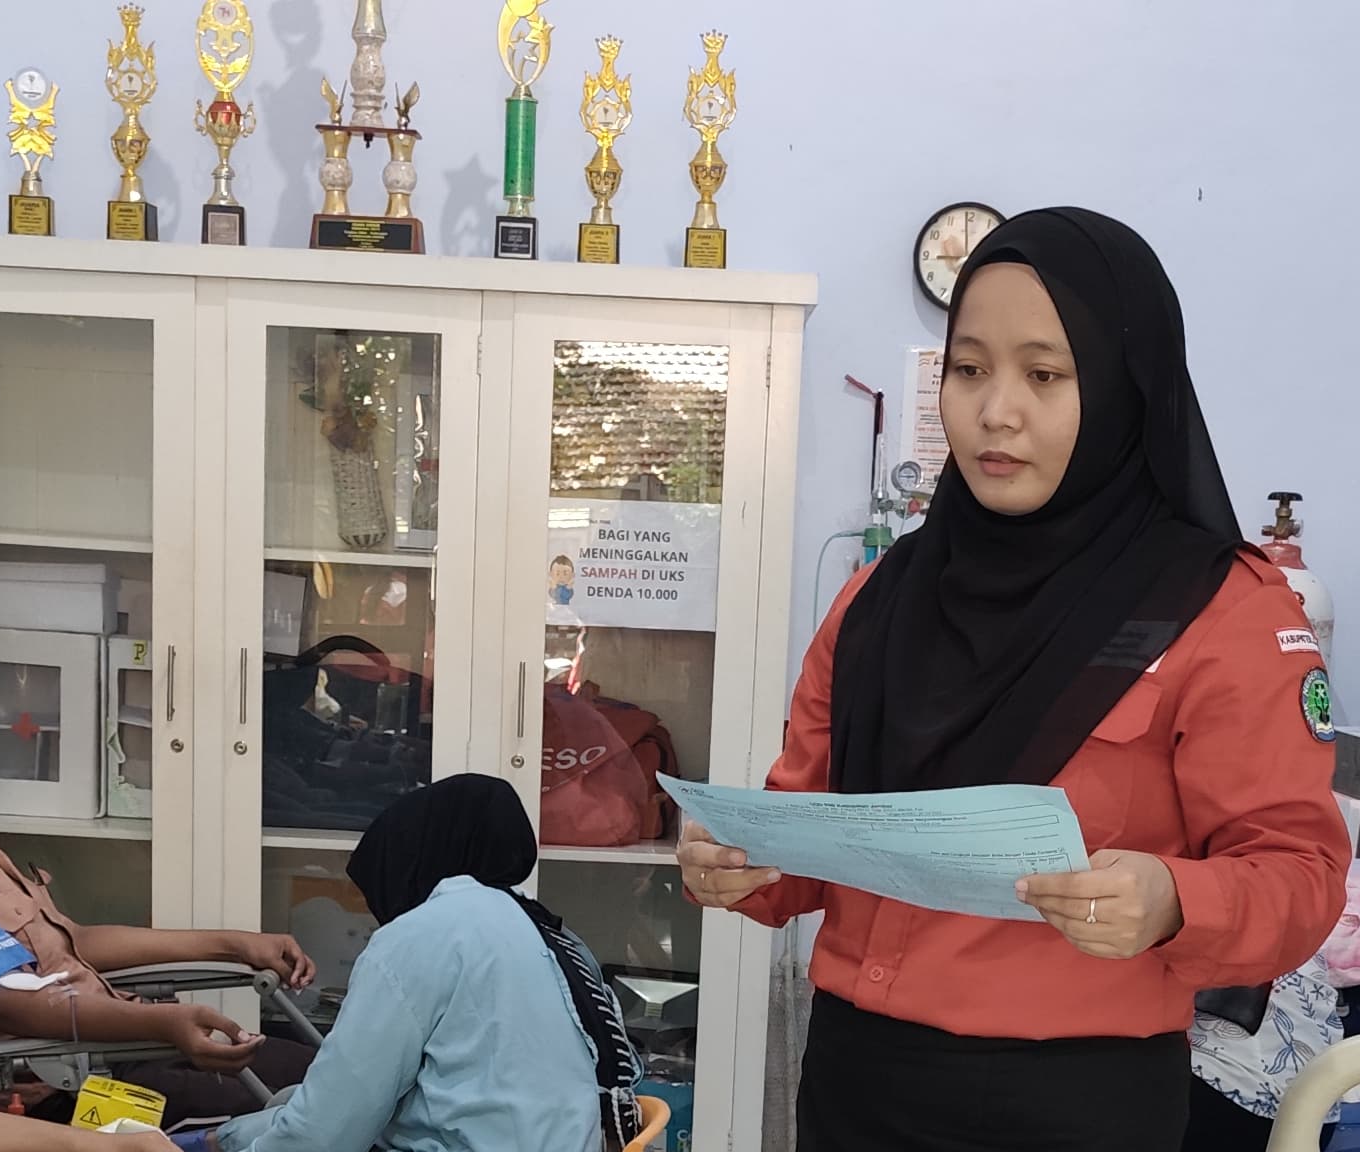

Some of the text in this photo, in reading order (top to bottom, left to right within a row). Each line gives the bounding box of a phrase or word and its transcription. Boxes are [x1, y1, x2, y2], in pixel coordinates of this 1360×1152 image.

[929, 230, 940, 240] 10
[922, 251, 930, 260] 9
[598, 528, 671, 543] BAGI YANG
[579, 548, 688, 562] MENINGGALKAN
[581, 566, 685, 582] SAMPAH DI UKS
[587, 586, 678, 600] DENDA 10.000
